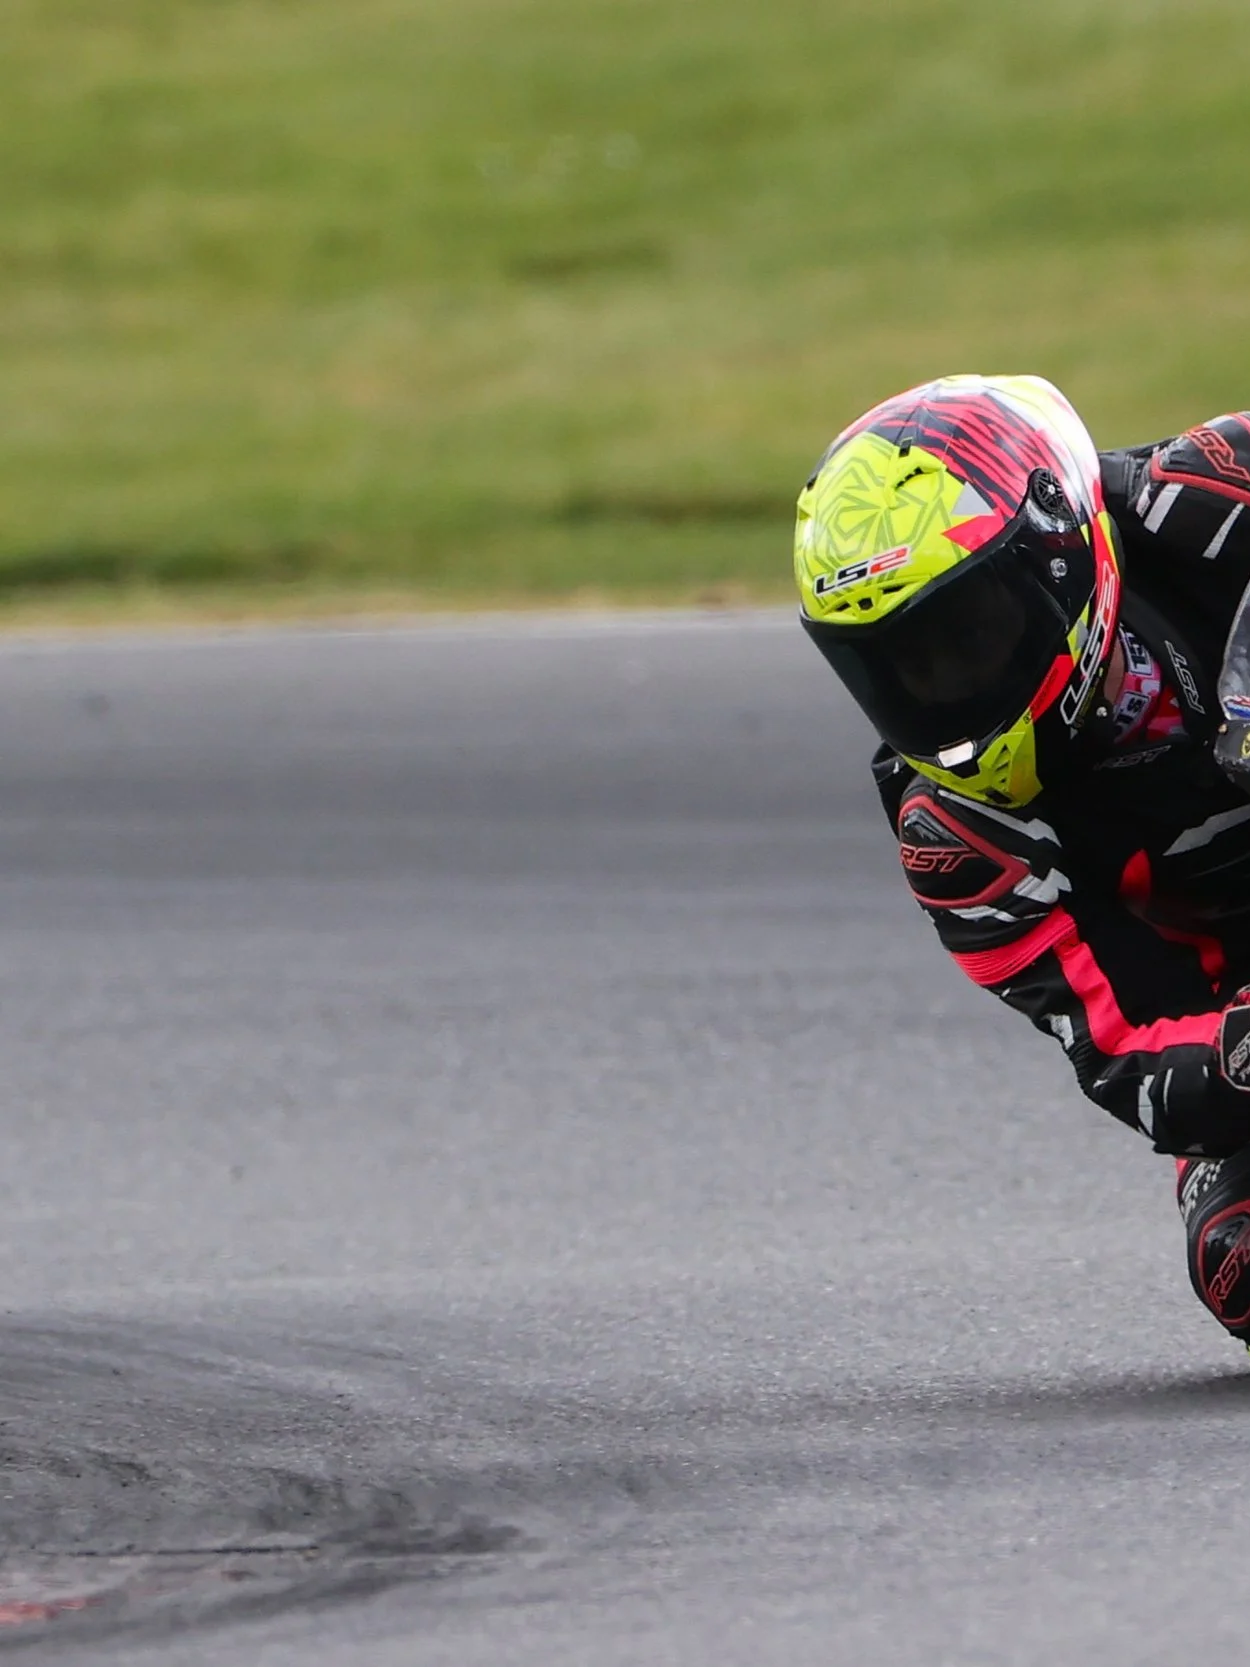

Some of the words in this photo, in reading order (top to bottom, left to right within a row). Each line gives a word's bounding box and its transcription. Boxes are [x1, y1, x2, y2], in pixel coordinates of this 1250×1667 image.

[814, 547, 910, 595] LS2
[1060, 562, 1117, 725] LS2
[1165, 640, 1206, 715] RST
[900, 844, 981, 873] RST
